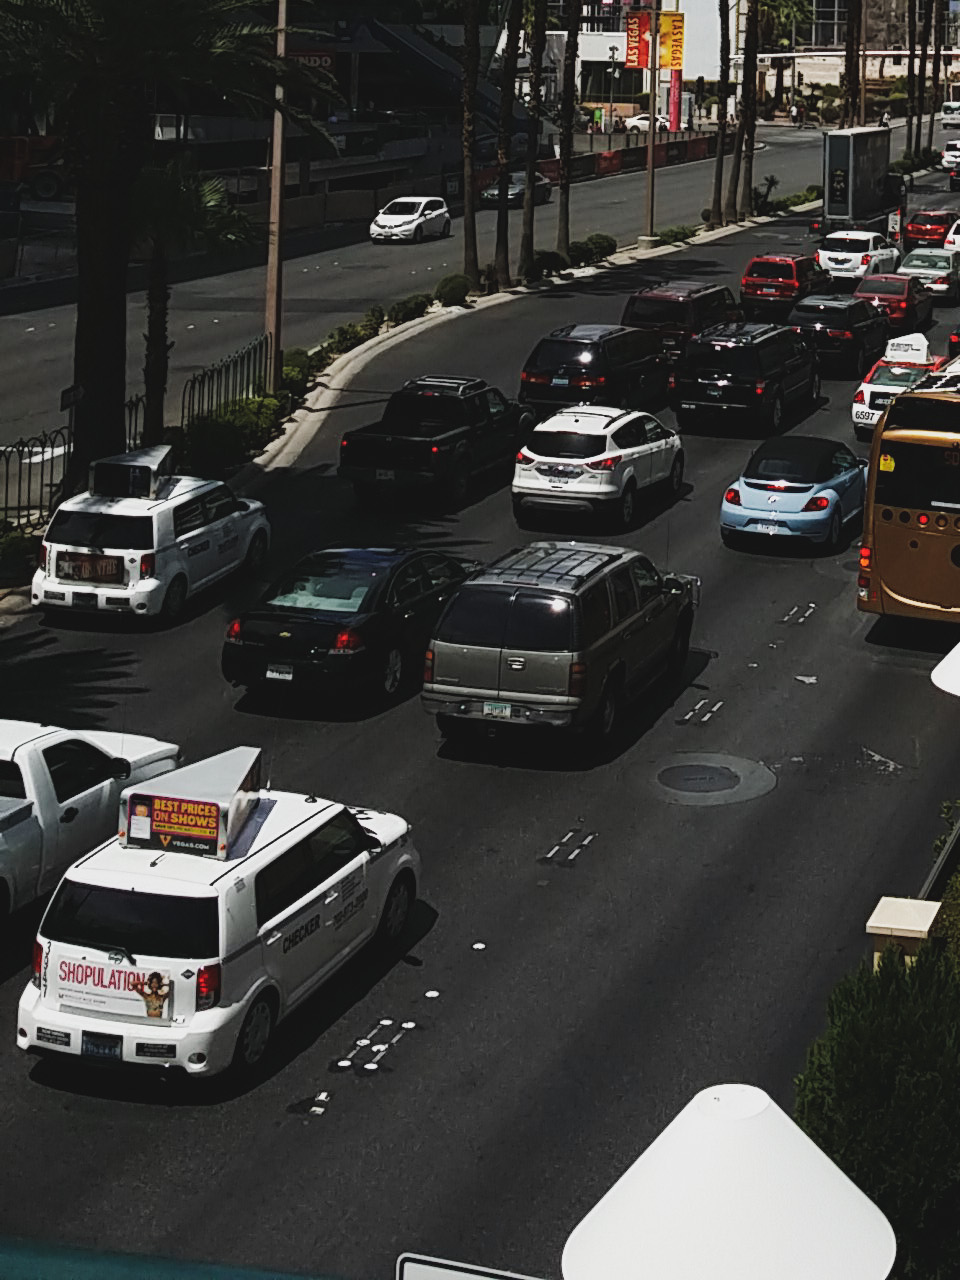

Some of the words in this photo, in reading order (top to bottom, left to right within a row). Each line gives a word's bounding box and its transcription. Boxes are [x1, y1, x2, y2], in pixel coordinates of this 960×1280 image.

[627, 17, 640, 48] VEGAS
[672, 15, 683, 36] LAS
[626, 47, 639, 66] LAS
[671, 37, 683, 67] VEGAS
[855, 410, 876, 421] 6597
[153, 798, 180, 812] BEST
[180, 803, 217, 817] PRICES
[153, 810, 169, 822] ON
[170, 814, 217, 828] SHOWS
[172, 840, 210, 850] VEGAS.COM
[282, 913, 321, 954] CHECKER
[59, 960, 147, 993] SHOPULATION
